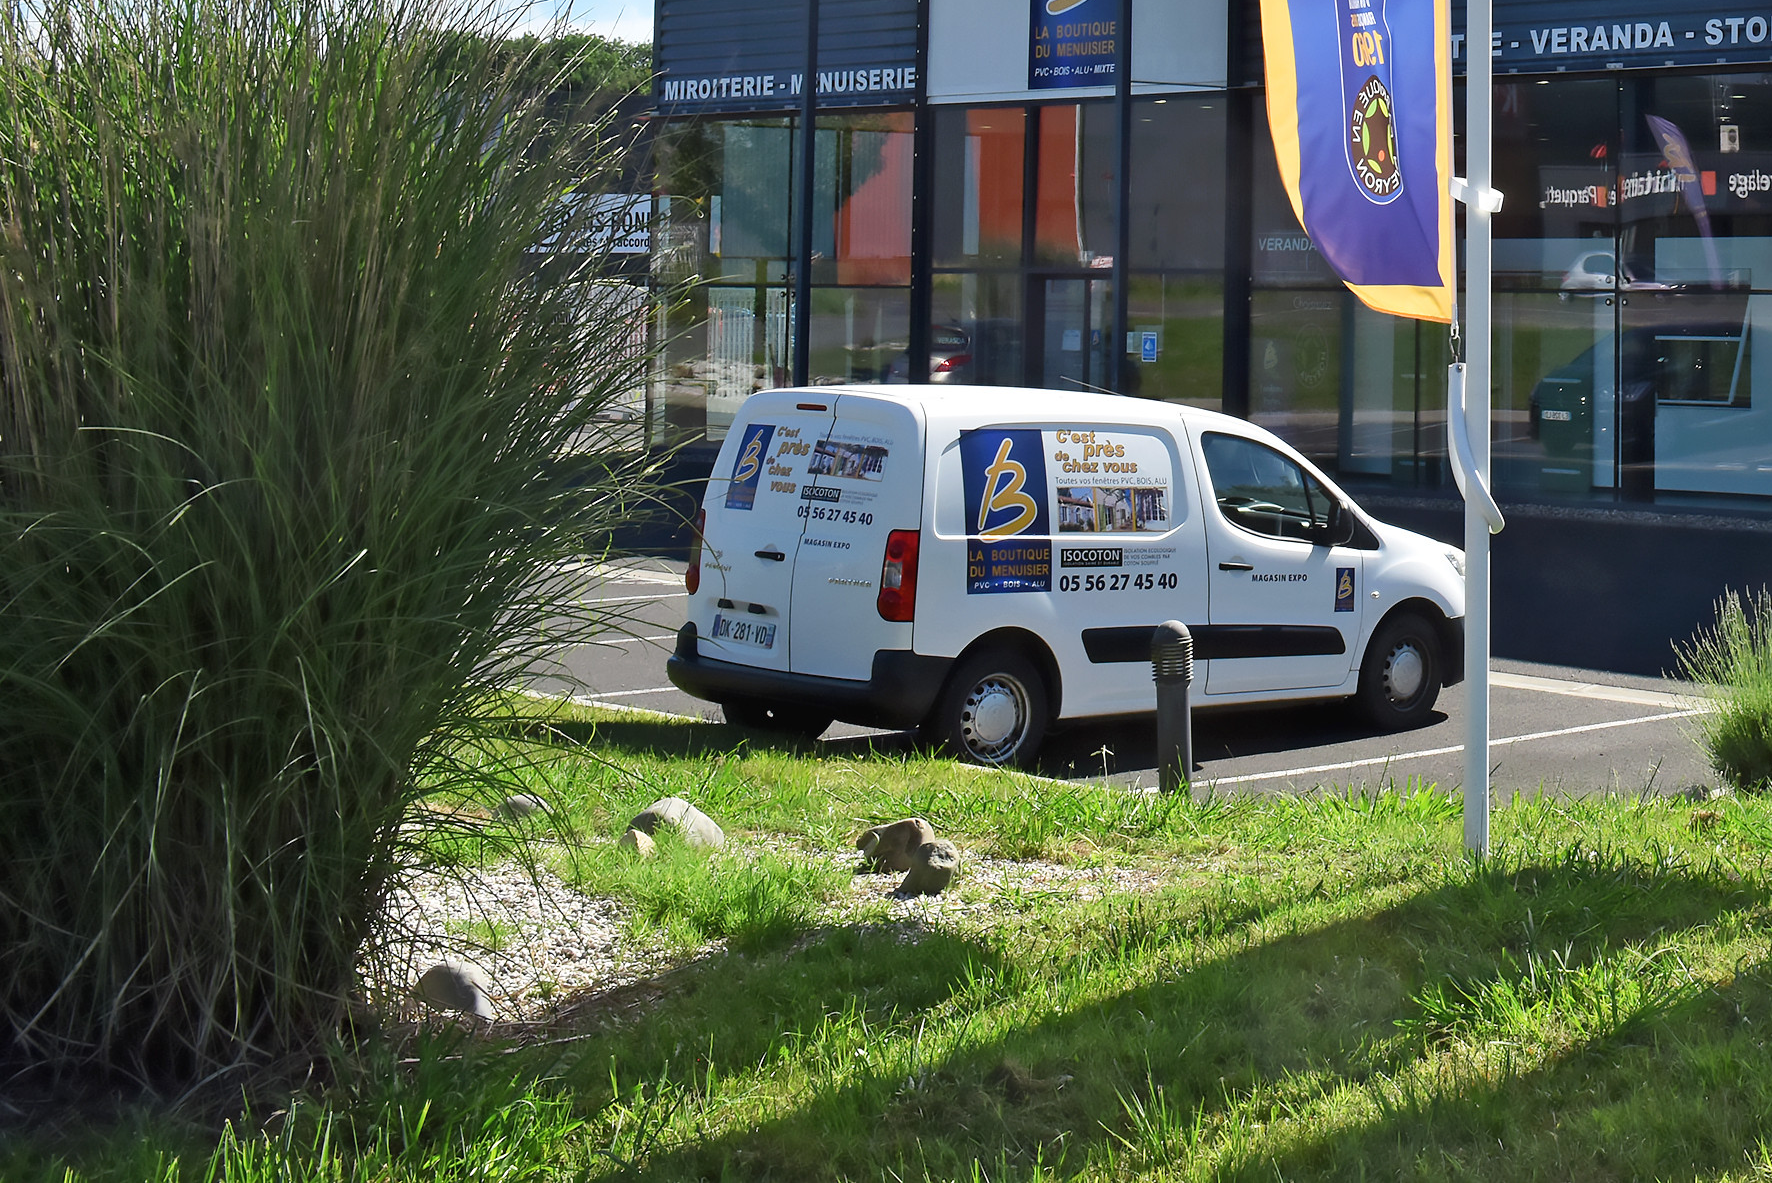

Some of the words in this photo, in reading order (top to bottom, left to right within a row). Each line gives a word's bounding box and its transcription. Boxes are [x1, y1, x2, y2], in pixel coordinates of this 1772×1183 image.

[1035, 25, 1049, 40] LA
[1056, 21, 1116, 37] BOUTIQUE
[1530, 21, 1675, 55] VERANDA
[1035, 44, 1050, 59] DU
[1057, 40, 1115, 57] MENUISIER
[1034, 67, 1050, 77] PVC
[1053, 66, 1070, 77] BOIS
[1074, 64, 1090, 75] ALU
[1093, 63, 1115, 74] MIXTE
[664, 75, 775, 101] MIROITERIE
[790, 67, 917, 96] MNUISERIE
[777, 426, 801, 439] C'est
[1056, 429, 1096, 444] C'est
[777, 438, 811, 457] près
[1083, 439, 1125, 461] près
[766, 456, 776, 466] de
[1054, 450, 1070, 462] de
[768, 464, 793, 478] chez
[1062, 458, 1099, 474] chez
[1103, 461, 1138, 474] vous
[770, 480, 797, 494] vous
[1055, 476, 1078, 485] Toutes
[1092, 476, 1119, 485] fenêtres
[1154, 476, 1167, 485] ALU
[803, 486, 840, 498] ISOCOTON
[977, 437, 1038, 544] B
[797, 505, 810, 518] 05
[812, 507, 825, 520] 56
[827, 508, 841, 522] 27
[842, 510, 857, 524] 45
[858, 512, 873, 526] 40
[804, 538, 832, 548] MAGASIN
[833, 540, 851, 550] EXPO
[969, 550, 984, 562] LA
[992, 547, 1050, 560] BOUTIQUE
[1063, 550, 1119, 562] ISOCOTON
[969, 566, 985, 578] DU
[992, 564, 1050, 578] MENUISIER
[1251, 574, 1287, 582] MAGASIN
[1288, 573, 1308, 582] EXPO
[974, 581, 990, 589] PVC
[1003, 580, 1021, 589] BOIS
[1031, 580, 1046, 588] ALU
[1060, 574, 1080, 592] 05
[1084, 574, 1106, 592] 56
[1109, 573, 1130, 591] 27
[1133, 573, 1154, 590] 45
[1157, 572, 1178, 589] 40
